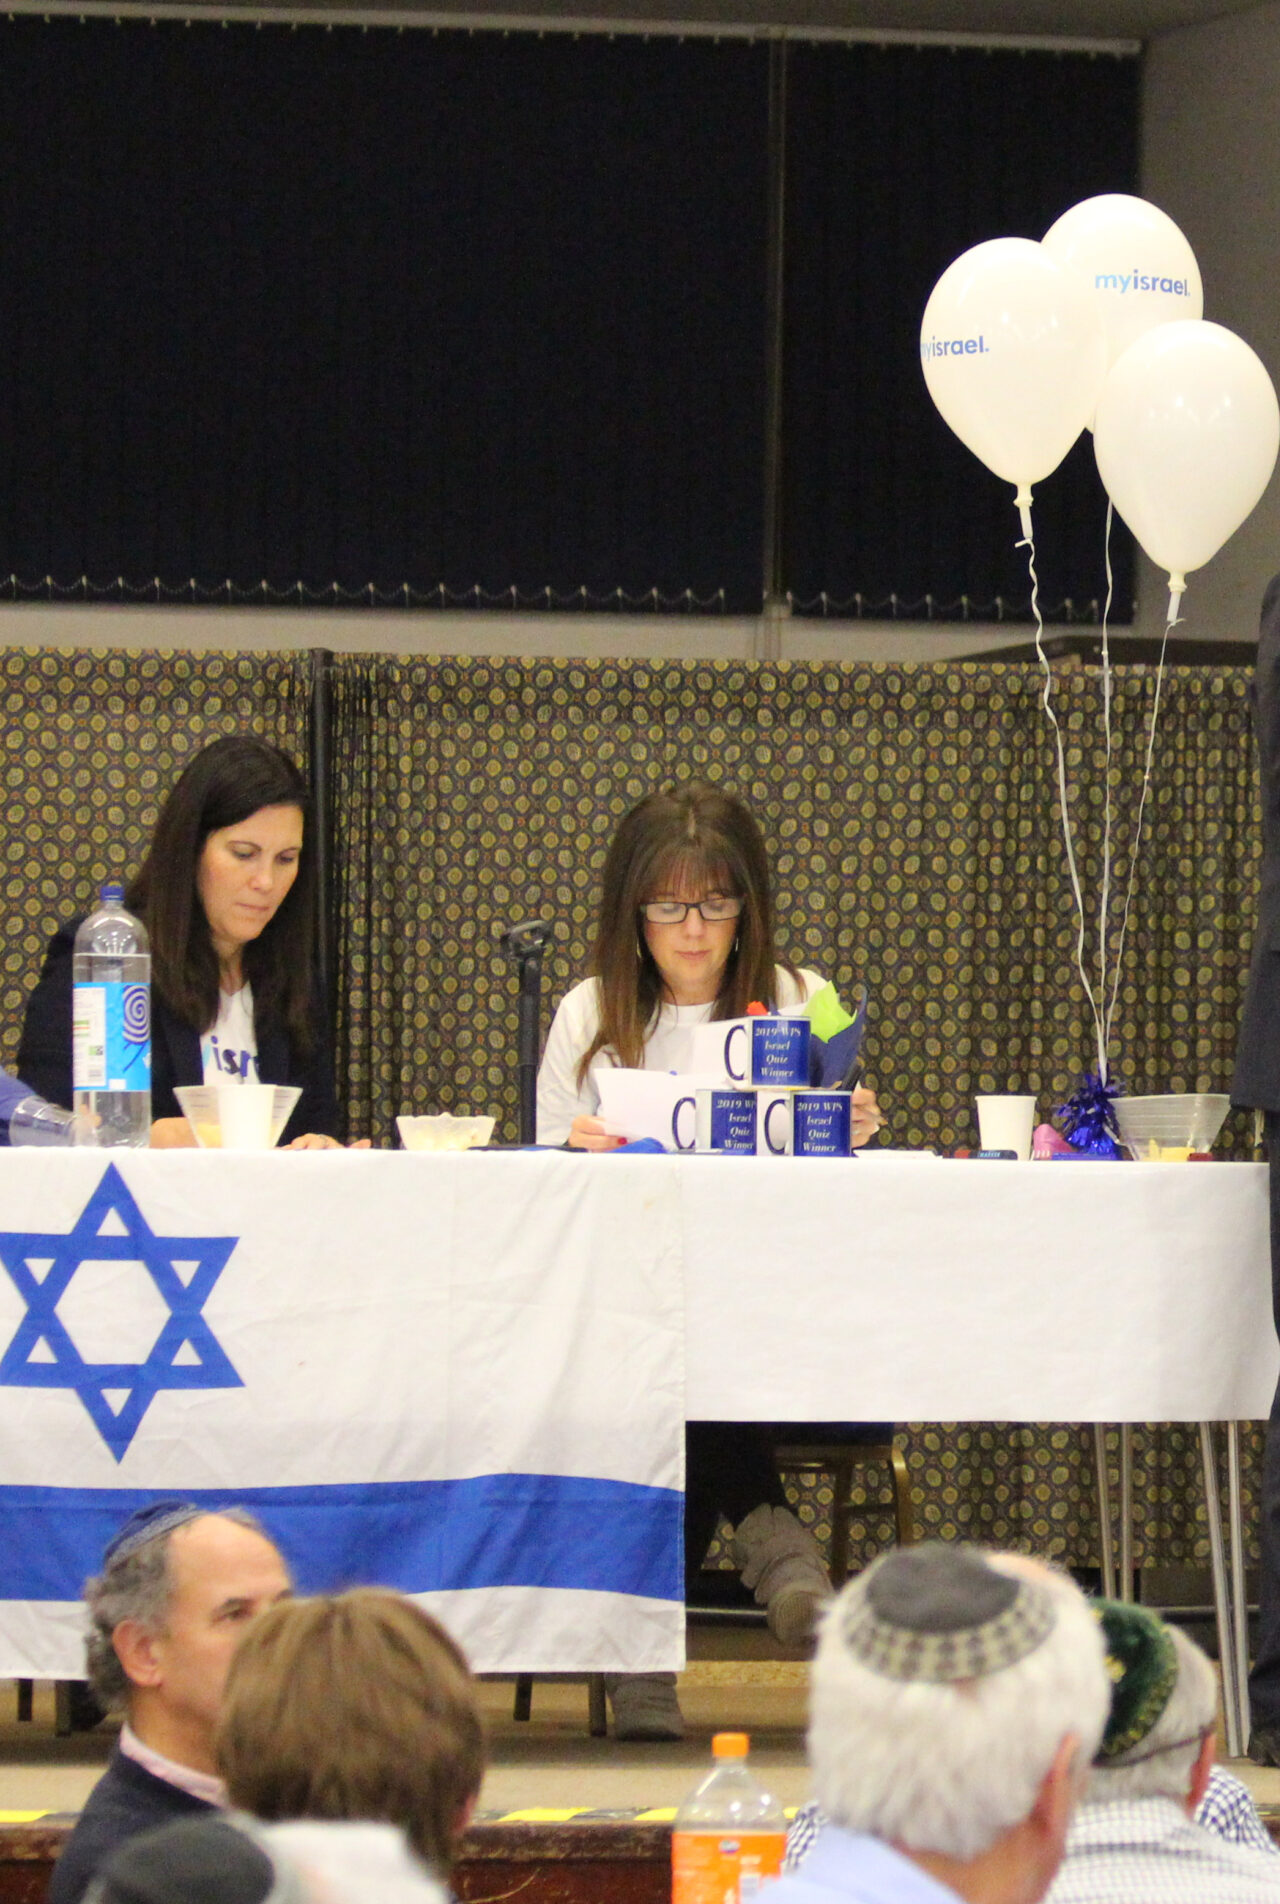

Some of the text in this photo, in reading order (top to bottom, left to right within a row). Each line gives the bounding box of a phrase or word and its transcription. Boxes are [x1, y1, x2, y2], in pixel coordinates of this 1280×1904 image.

[755, 1027, 777, 1037] 2019
[765, 1040, 790, 1050] Israel
[766, 1054, 788, 1065] Quiz
[761, 1067, 794, 1077] Winner
[716, 1099, 741, 1109] 2019
[797, 1102, 820, 1111] 2019
[729, 1112, 752, 1122] Israel
[807, 1115, 832, 1125] Israel
[808, 1129, 830, 1140] Quiz
[803, 1142, 836, 1152] Winner
